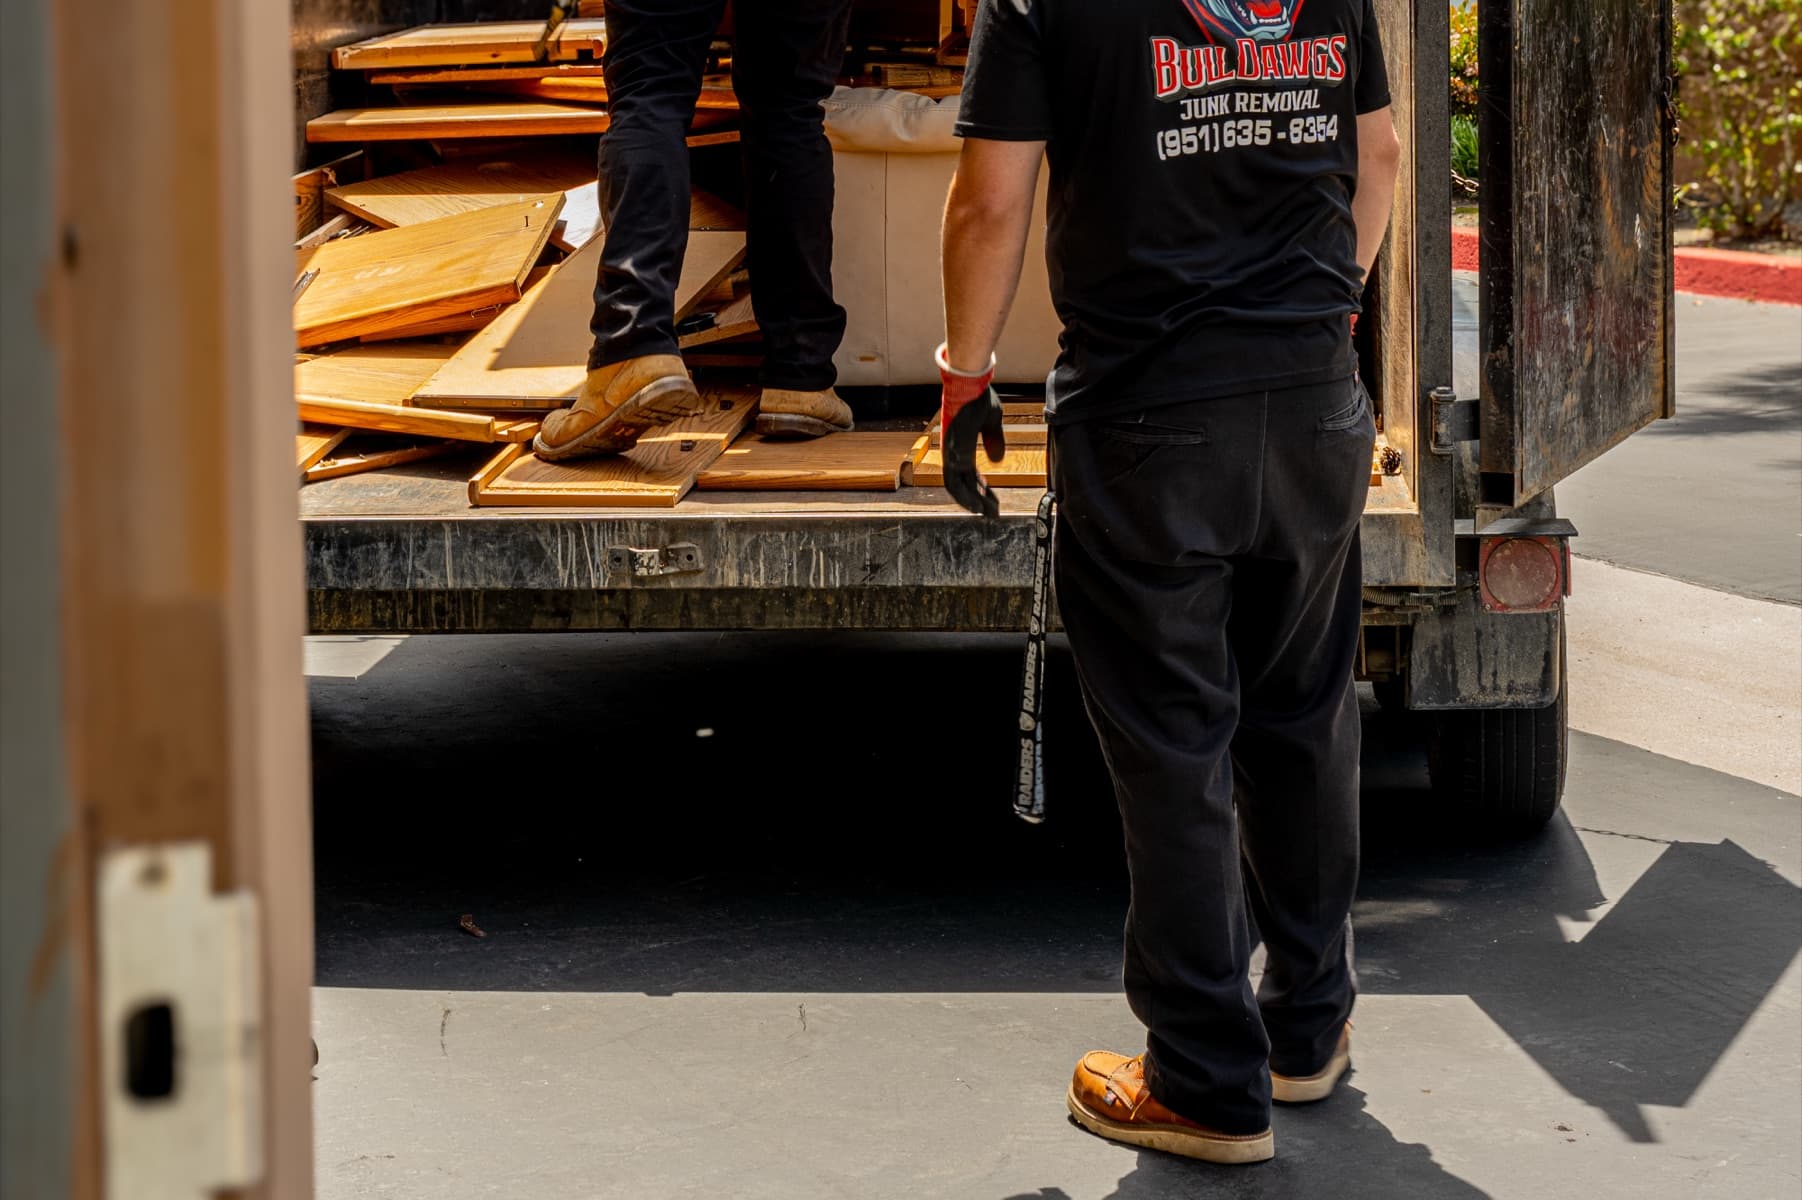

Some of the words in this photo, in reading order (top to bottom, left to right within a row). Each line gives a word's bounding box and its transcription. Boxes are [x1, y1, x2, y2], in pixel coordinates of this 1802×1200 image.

[1180, 94, 1230, 121] JUNK
[1234, 88, 1321, 114] REMOVAL
[1033, 545, 1046, 617] RAIDERS
[1023, 641, 1038, 713] RAIDERS
[1018, 738, 1034, 805] RAIDERS
